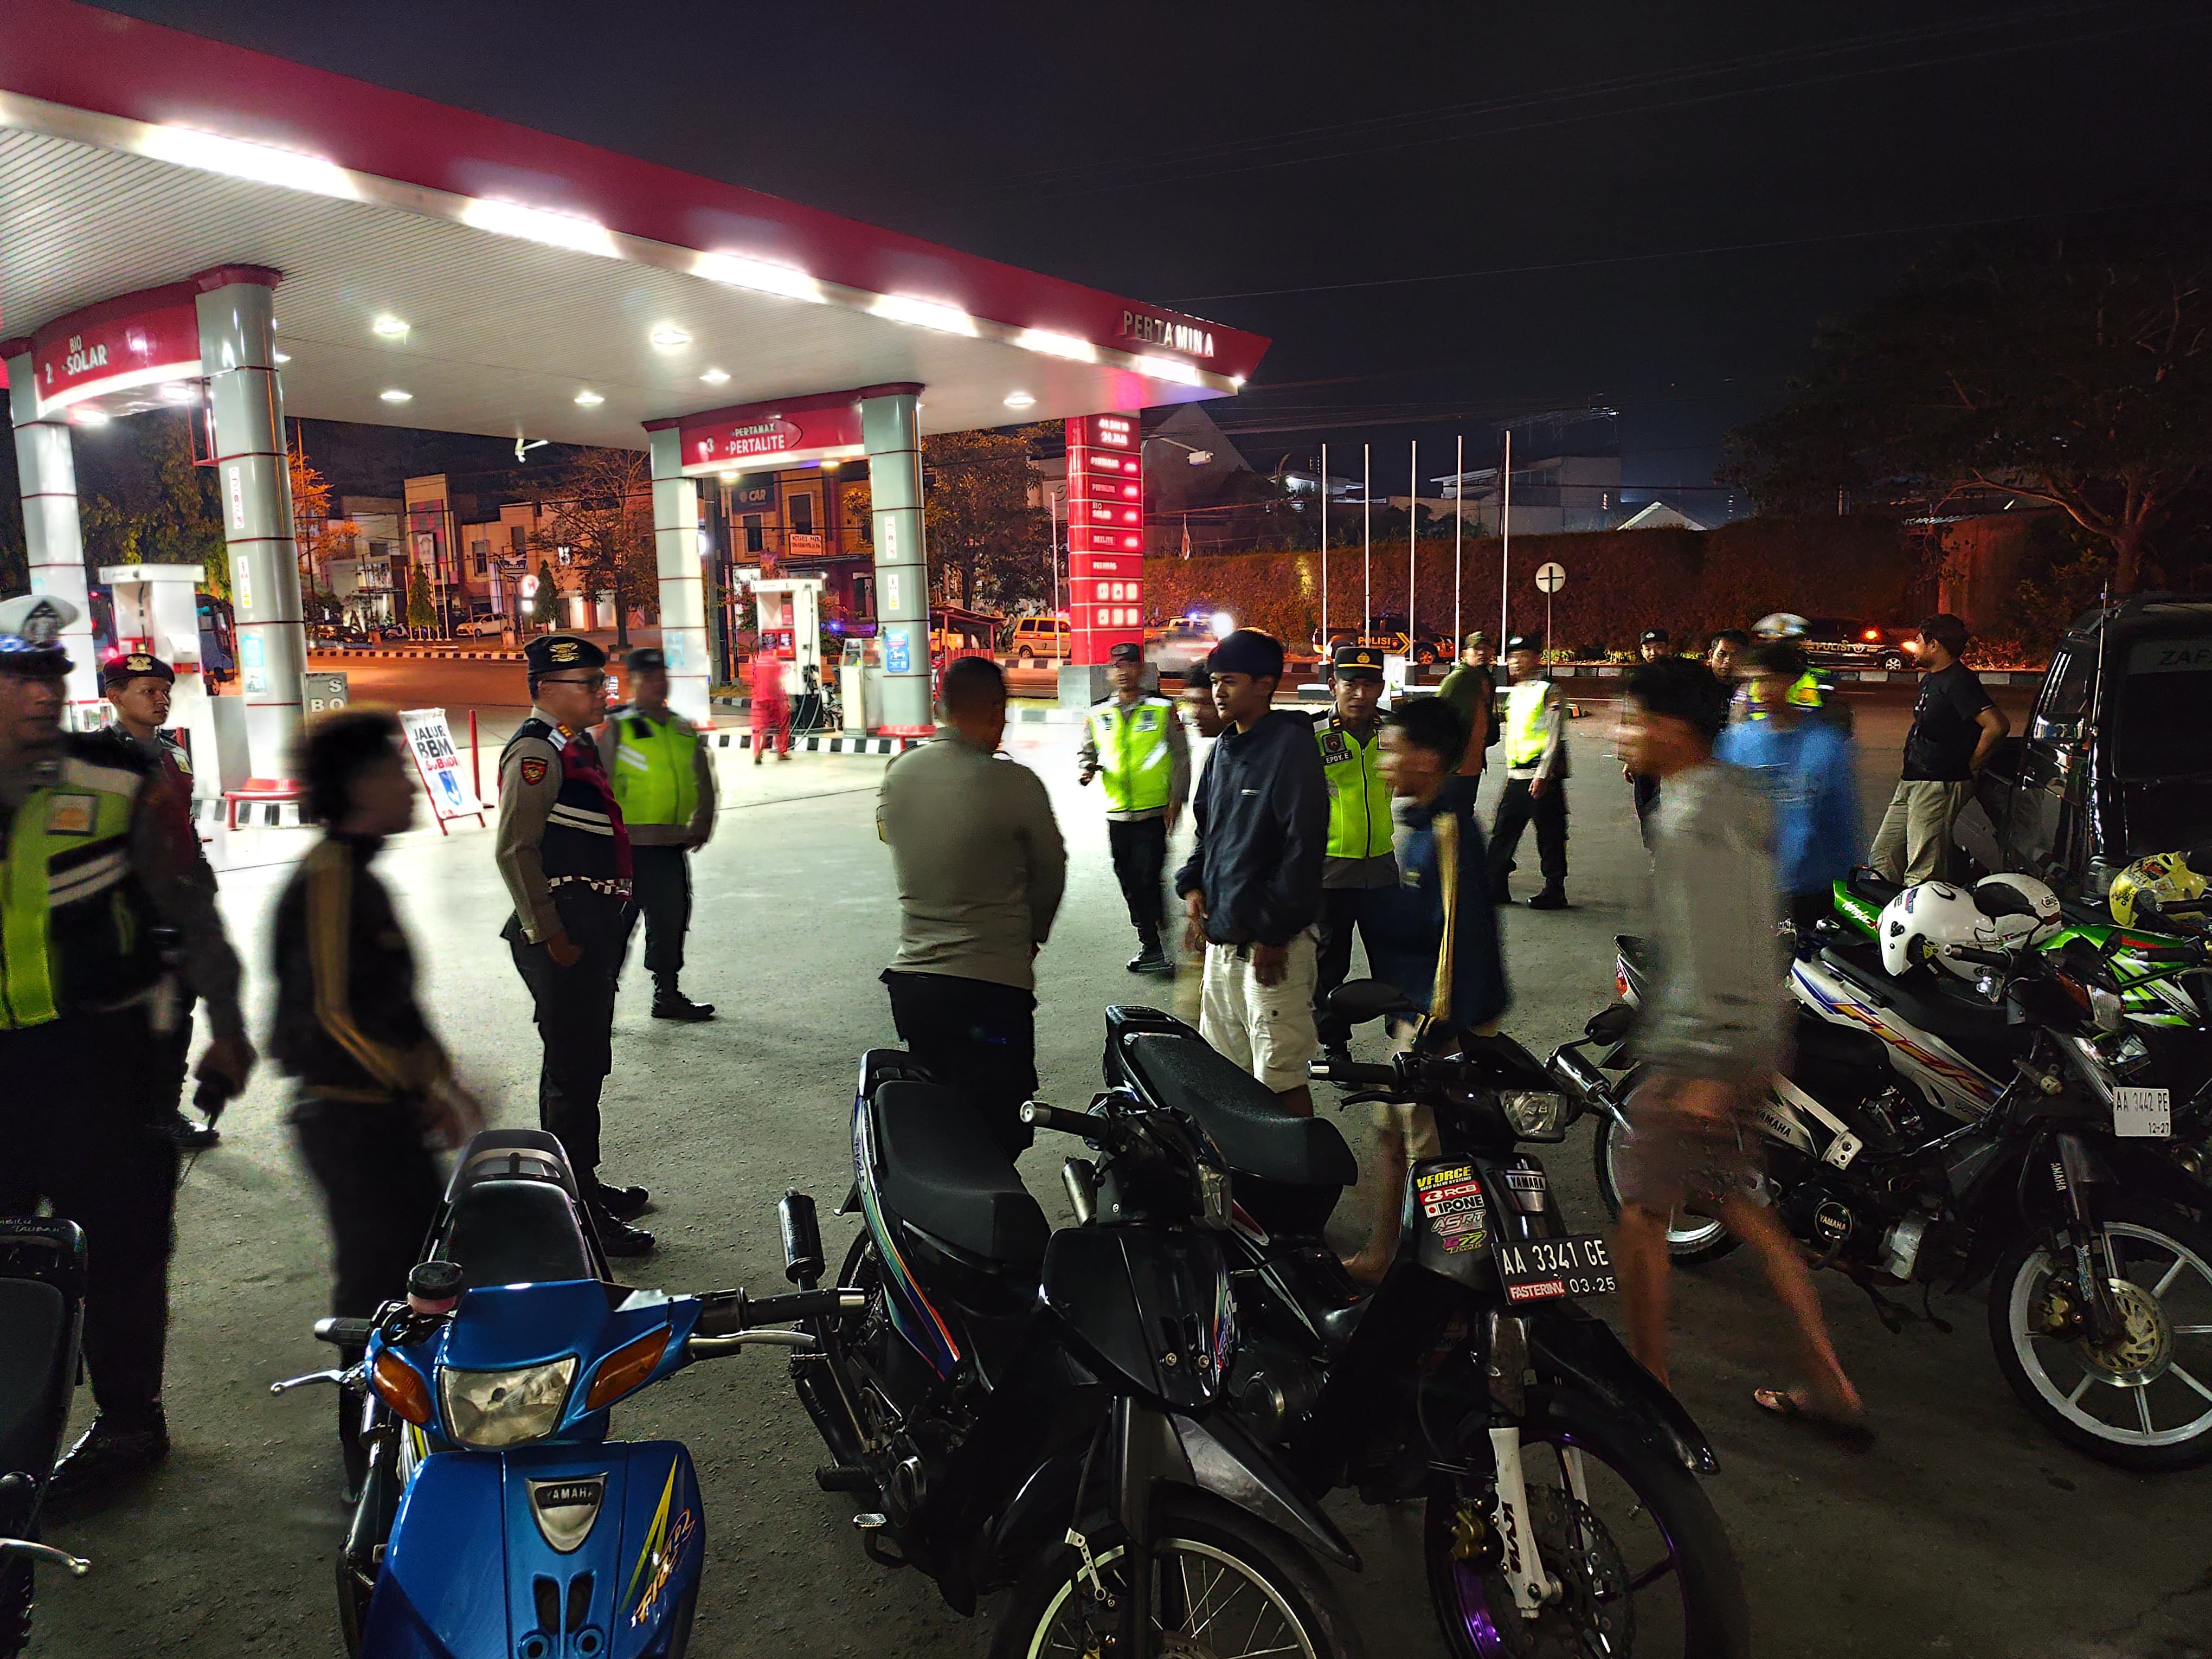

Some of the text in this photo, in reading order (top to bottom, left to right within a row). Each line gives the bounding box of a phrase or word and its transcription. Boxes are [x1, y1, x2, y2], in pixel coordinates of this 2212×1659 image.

[1123, 310, 1214, 357] PERTAMINA
[69, 334, 82, 353] BIO
[67, 344, 107, 376] SOLAR
[735, 423, 775, 437] PERTAMAX
[706, 438, 714, 453] 3
[730, 434, 785, 454] PERTALITE
[749, 488, 766, 501] CAR
[1092, 501, 1102, 510] BIO
[1358, 636, 1391, 645] POLISI
[2159, 649, 2212, 666] ZAF
[414, 725, 447, 741] JALUR
[416, 738, 454, 759] BBM
[426, 756, 458, 771] SUBSIDI
[2116, 1091, 2168, 1111] AA 3442 PE
[2148, 1122, 2169, 1134] 12-27
[1416, 1166, 1472, 1188] VFORCE
[1510, 1175, 1545, 1189] YAMAHA
[1444, 1184, 1477, 1197] RCB
[1438, 1195, 1484, 1214] IPONE
[1819, 1213, 1846, 1231] YAMAHA
[1502, 1246, 1527, 1275] AA
[1532, 1242, 1579, 1271] 3341
[1584, 1239, 1610, 1266] GE
[1569, 1276, 1616, 1293] 03.25
[546, 1487, 593, 1500] YAMAHA
